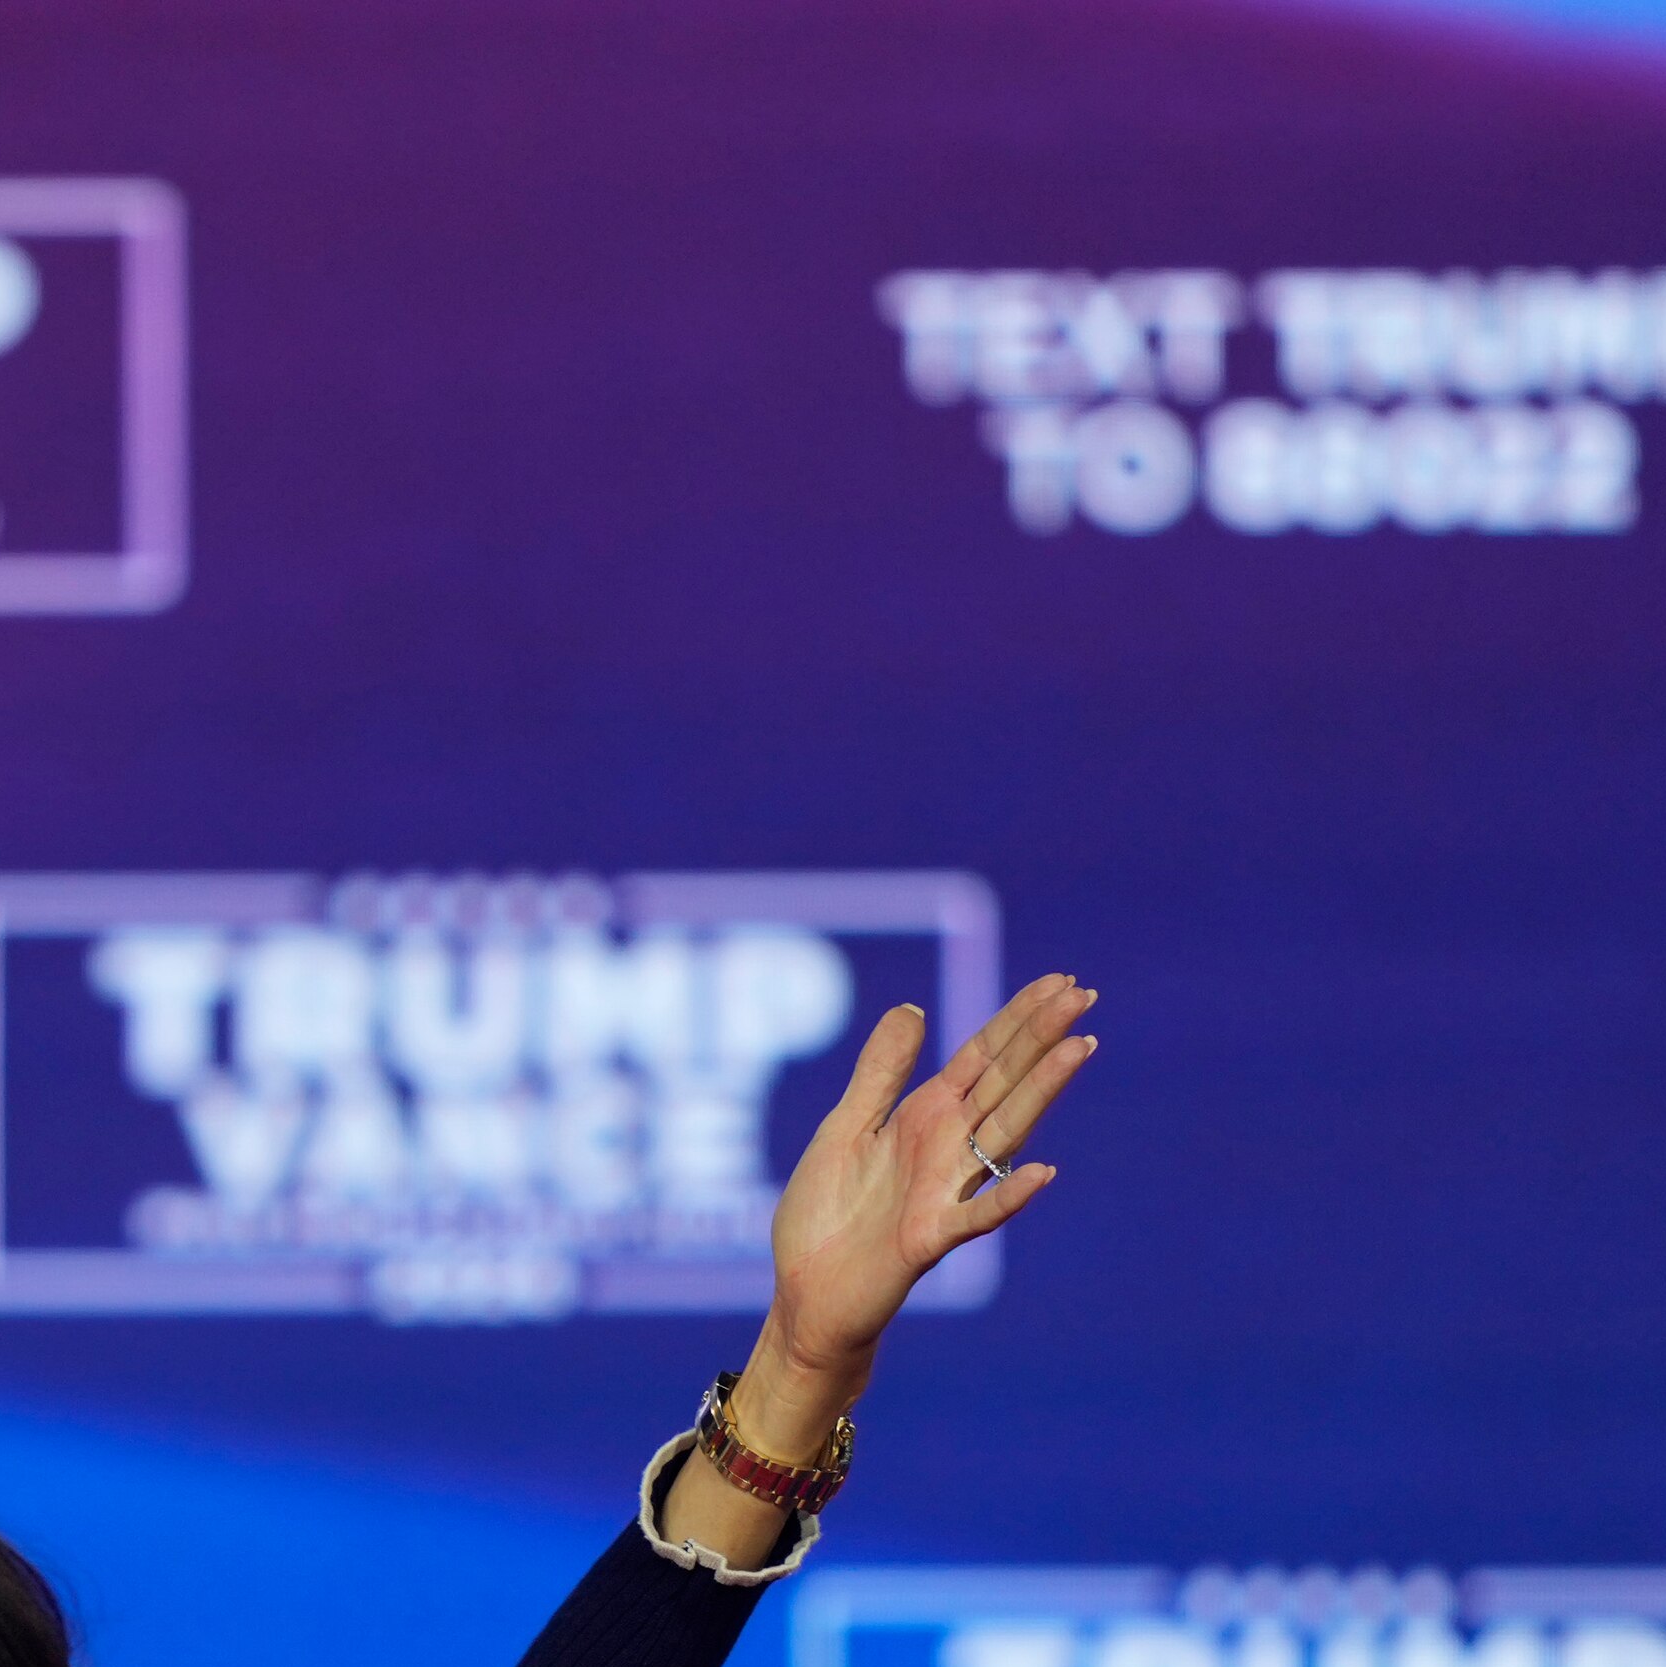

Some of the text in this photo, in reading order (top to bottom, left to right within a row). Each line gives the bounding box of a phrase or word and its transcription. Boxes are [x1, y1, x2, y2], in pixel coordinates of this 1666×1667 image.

[877, 268, 1247, 403] TEXT
[979, 399, 1197, 534] TO
[88, 926, 853, 1097] TRUMP
[175, 1076, 768, 1205] VANCE
